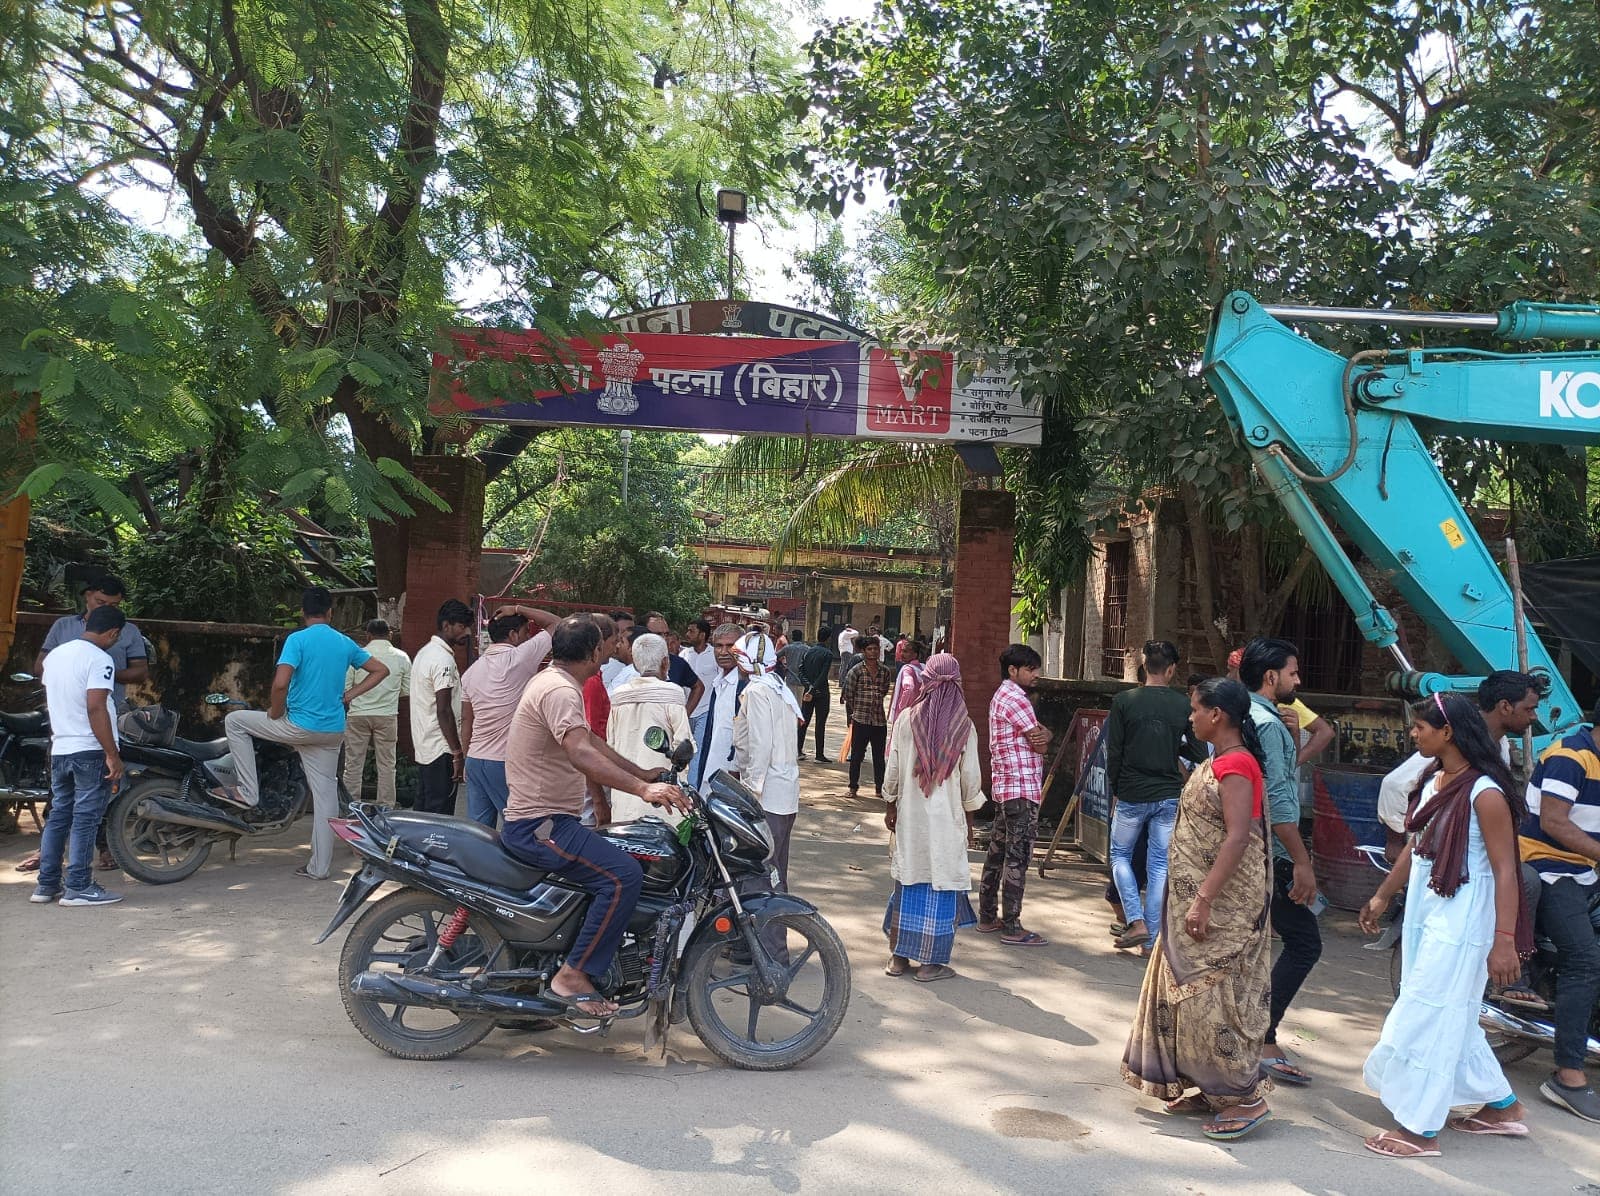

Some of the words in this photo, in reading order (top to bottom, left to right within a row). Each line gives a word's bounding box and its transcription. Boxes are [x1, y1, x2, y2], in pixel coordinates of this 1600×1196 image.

[649, 367, 724, 396] पटना
[734, 363, 842, 409] (बिहार)
[875, 403, 942, 426] MART
[968, 428, 987, 437] पटना
[103, 666, 114, 680] 3
[496, 907, 515, 918] Hero
